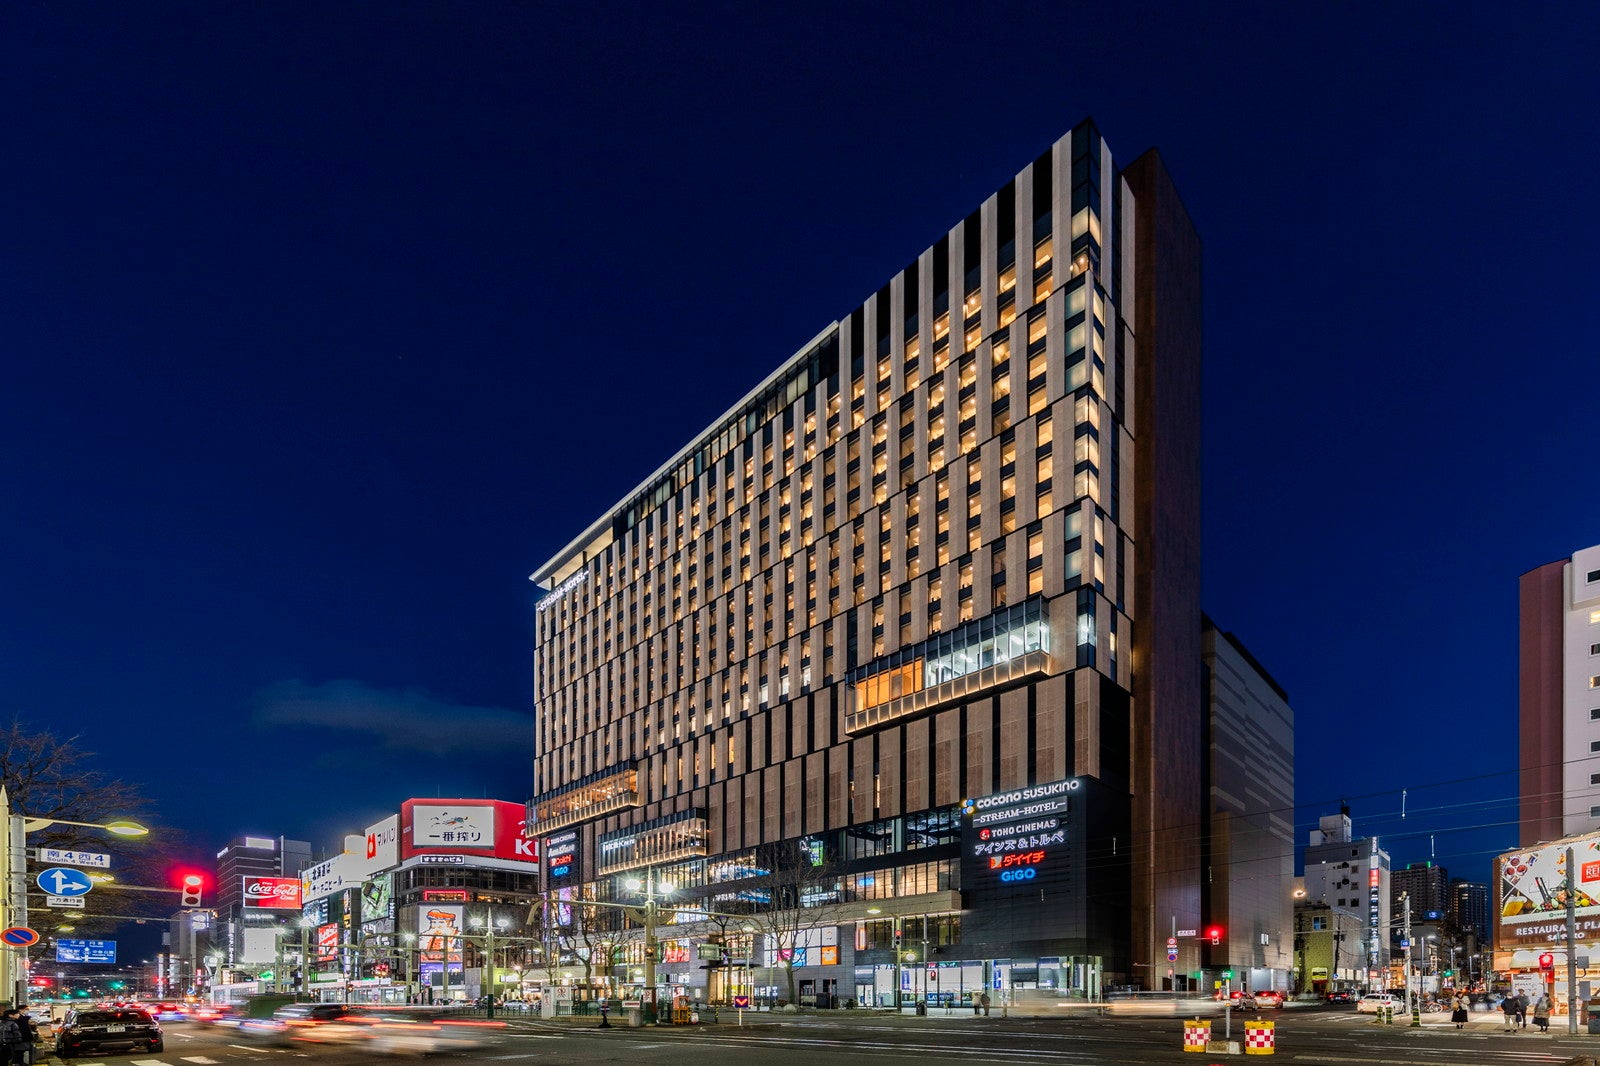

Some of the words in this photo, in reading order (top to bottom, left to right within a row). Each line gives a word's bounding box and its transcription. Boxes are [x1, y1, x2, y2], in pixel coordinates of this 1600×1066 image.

[991, 826, 1014, 837] TOHO
[1016, 819, 1057, 834] CINEMAS
[429, 831, 481, 842] 一番搾り
[1003, 850, 1045, 867] ダイイチ
[1001, 867, 1036, 882] GiGO
[248, 883, 299, 896] Coca-Cola
[1516, 922, 1581, 936] RESTAURAT
